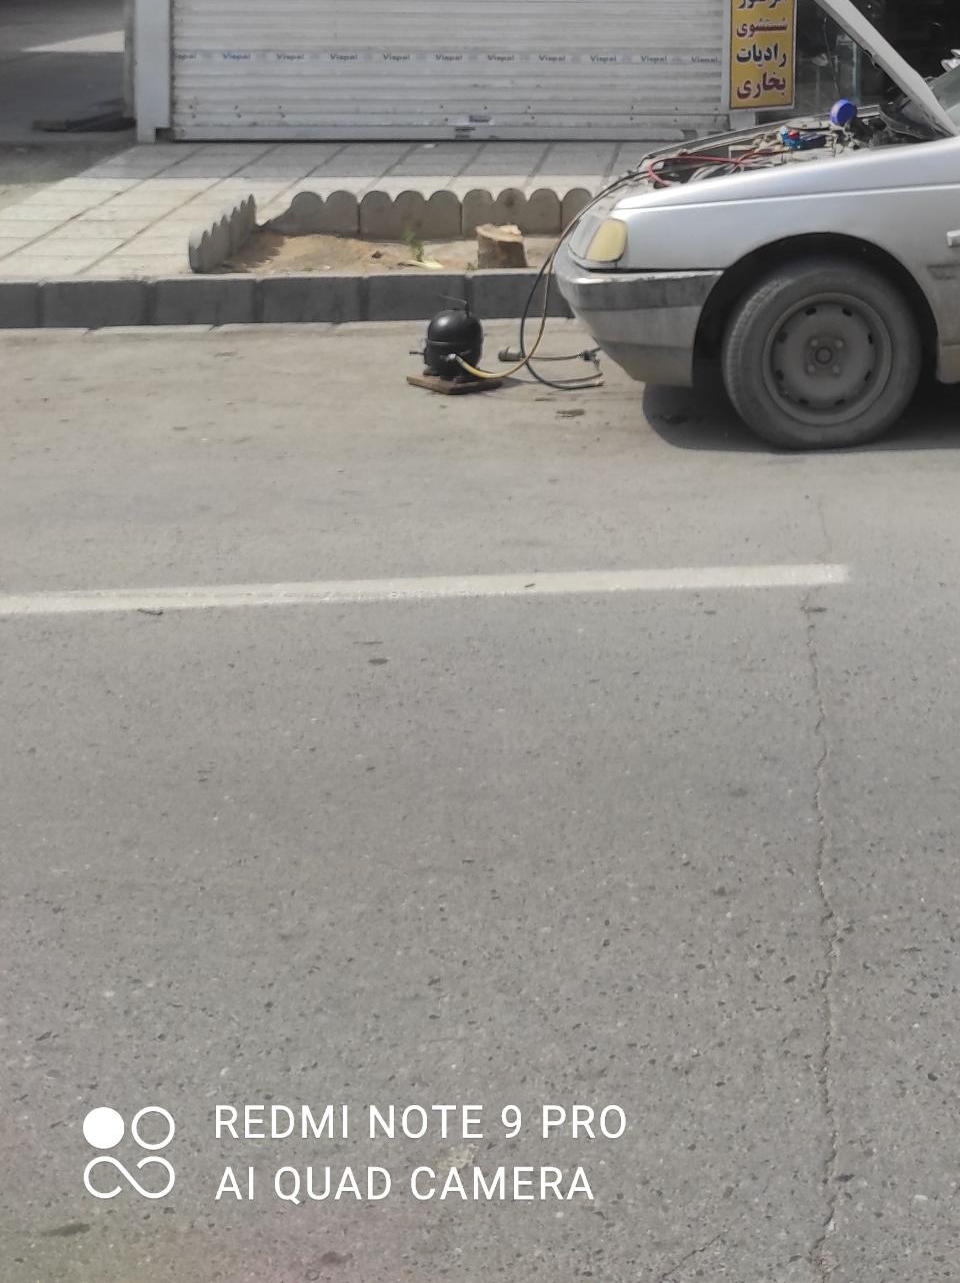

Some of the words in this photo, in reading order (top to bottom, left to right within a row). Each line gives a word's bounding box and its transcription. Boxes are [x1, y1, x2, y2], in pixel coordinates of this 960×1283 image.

[736, 18, 787, 37] شستشوی
[736, 43, 786, 67] رادیات
[737, 72, 786, 99] بخاری
